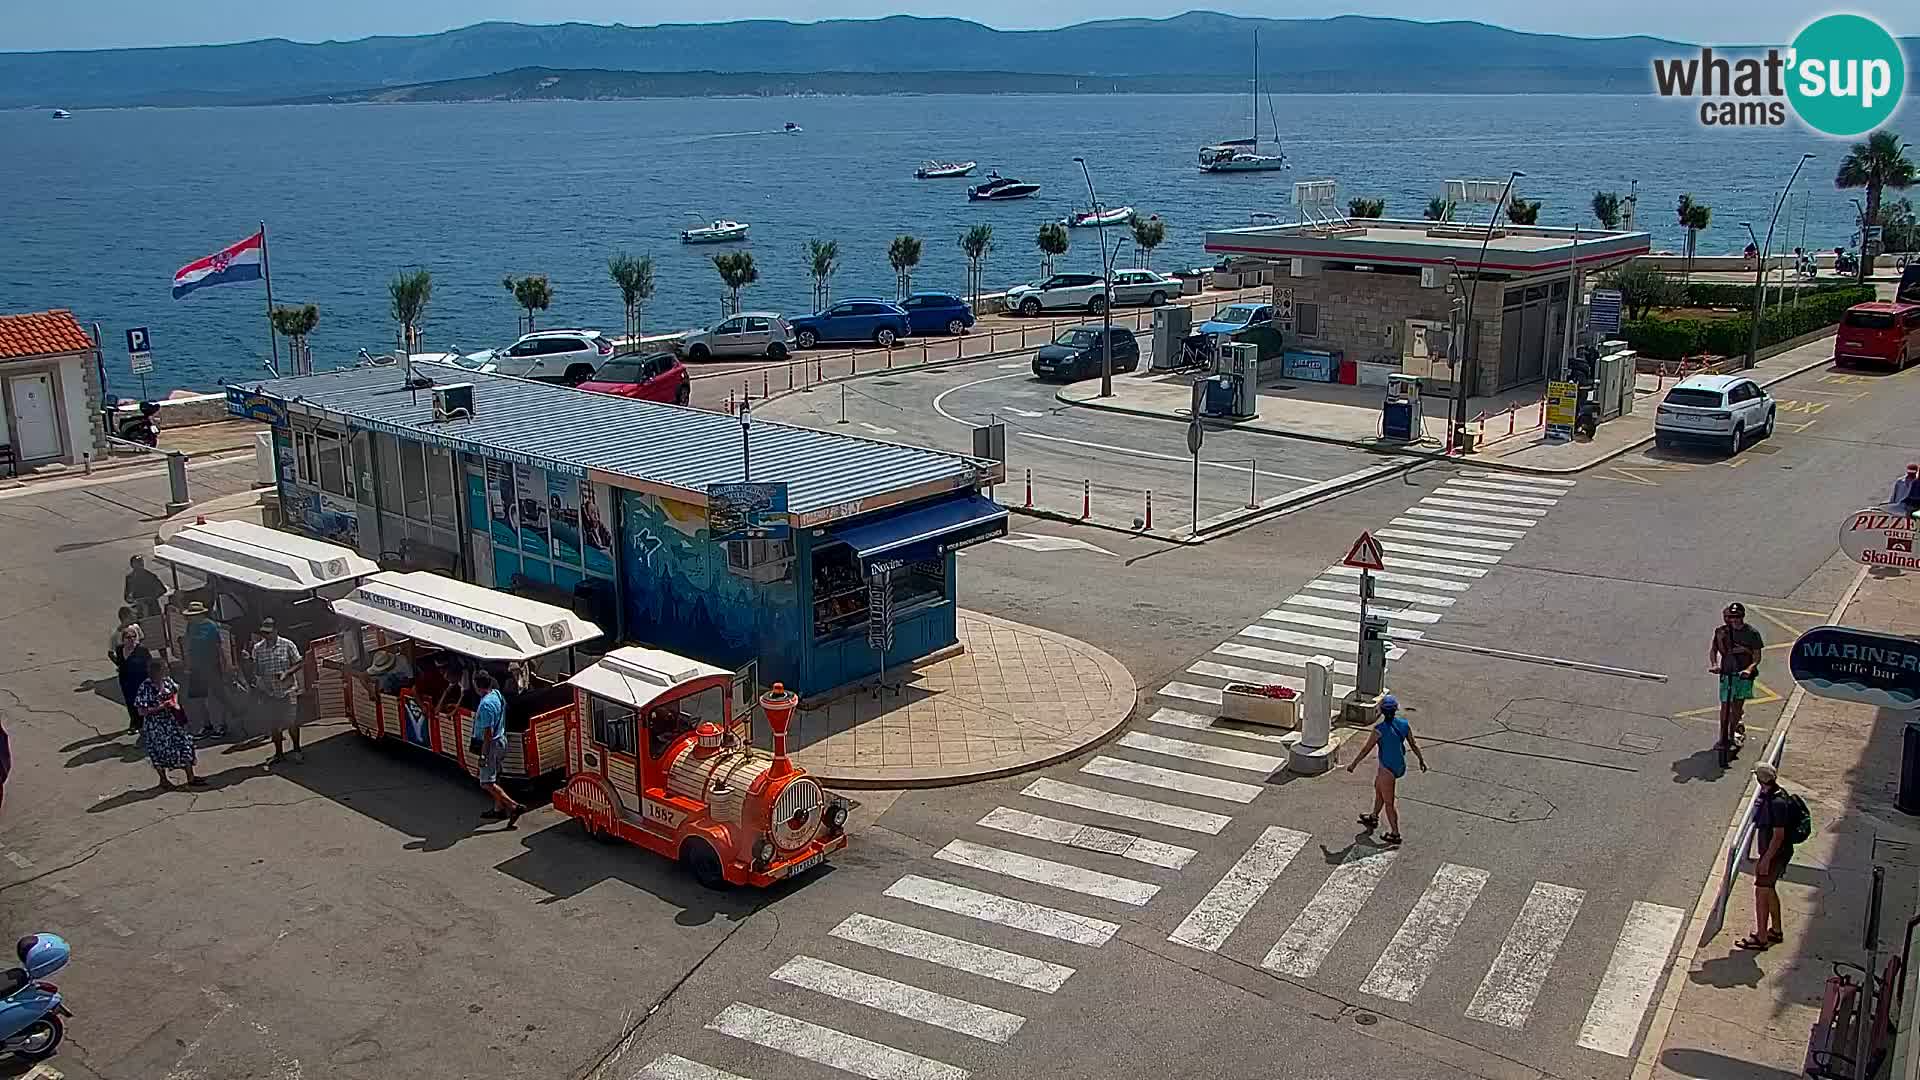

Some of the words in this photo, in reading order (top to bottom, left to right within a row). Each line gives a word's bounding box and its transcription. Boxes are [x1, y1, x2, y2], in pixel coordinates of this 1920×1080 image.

[131, 331, 144, 349] P
[438, 437, 469, 450] POSTAJA
[480, 446, 494, 456] BUS
[495, 450, 527, 464] STATION
[529, 457, 555, 471] TICKET
[556, 463, 583, 477] OFFICE
[1849, 515, 1920, 532] PIZZE
[1884, 530, 1918, 540] GRILL
[359, 590, 371, 600] BOL
[373, 593, 396, 608] CENTER
[400, 600, 420, 615] BEACH
[461, 619, 475, 632] BOL
[475, 622, 501, 639] CENTER
[1803, 642, 1920, 672] MARINER
[1872, 665, 1900, 680] bar
